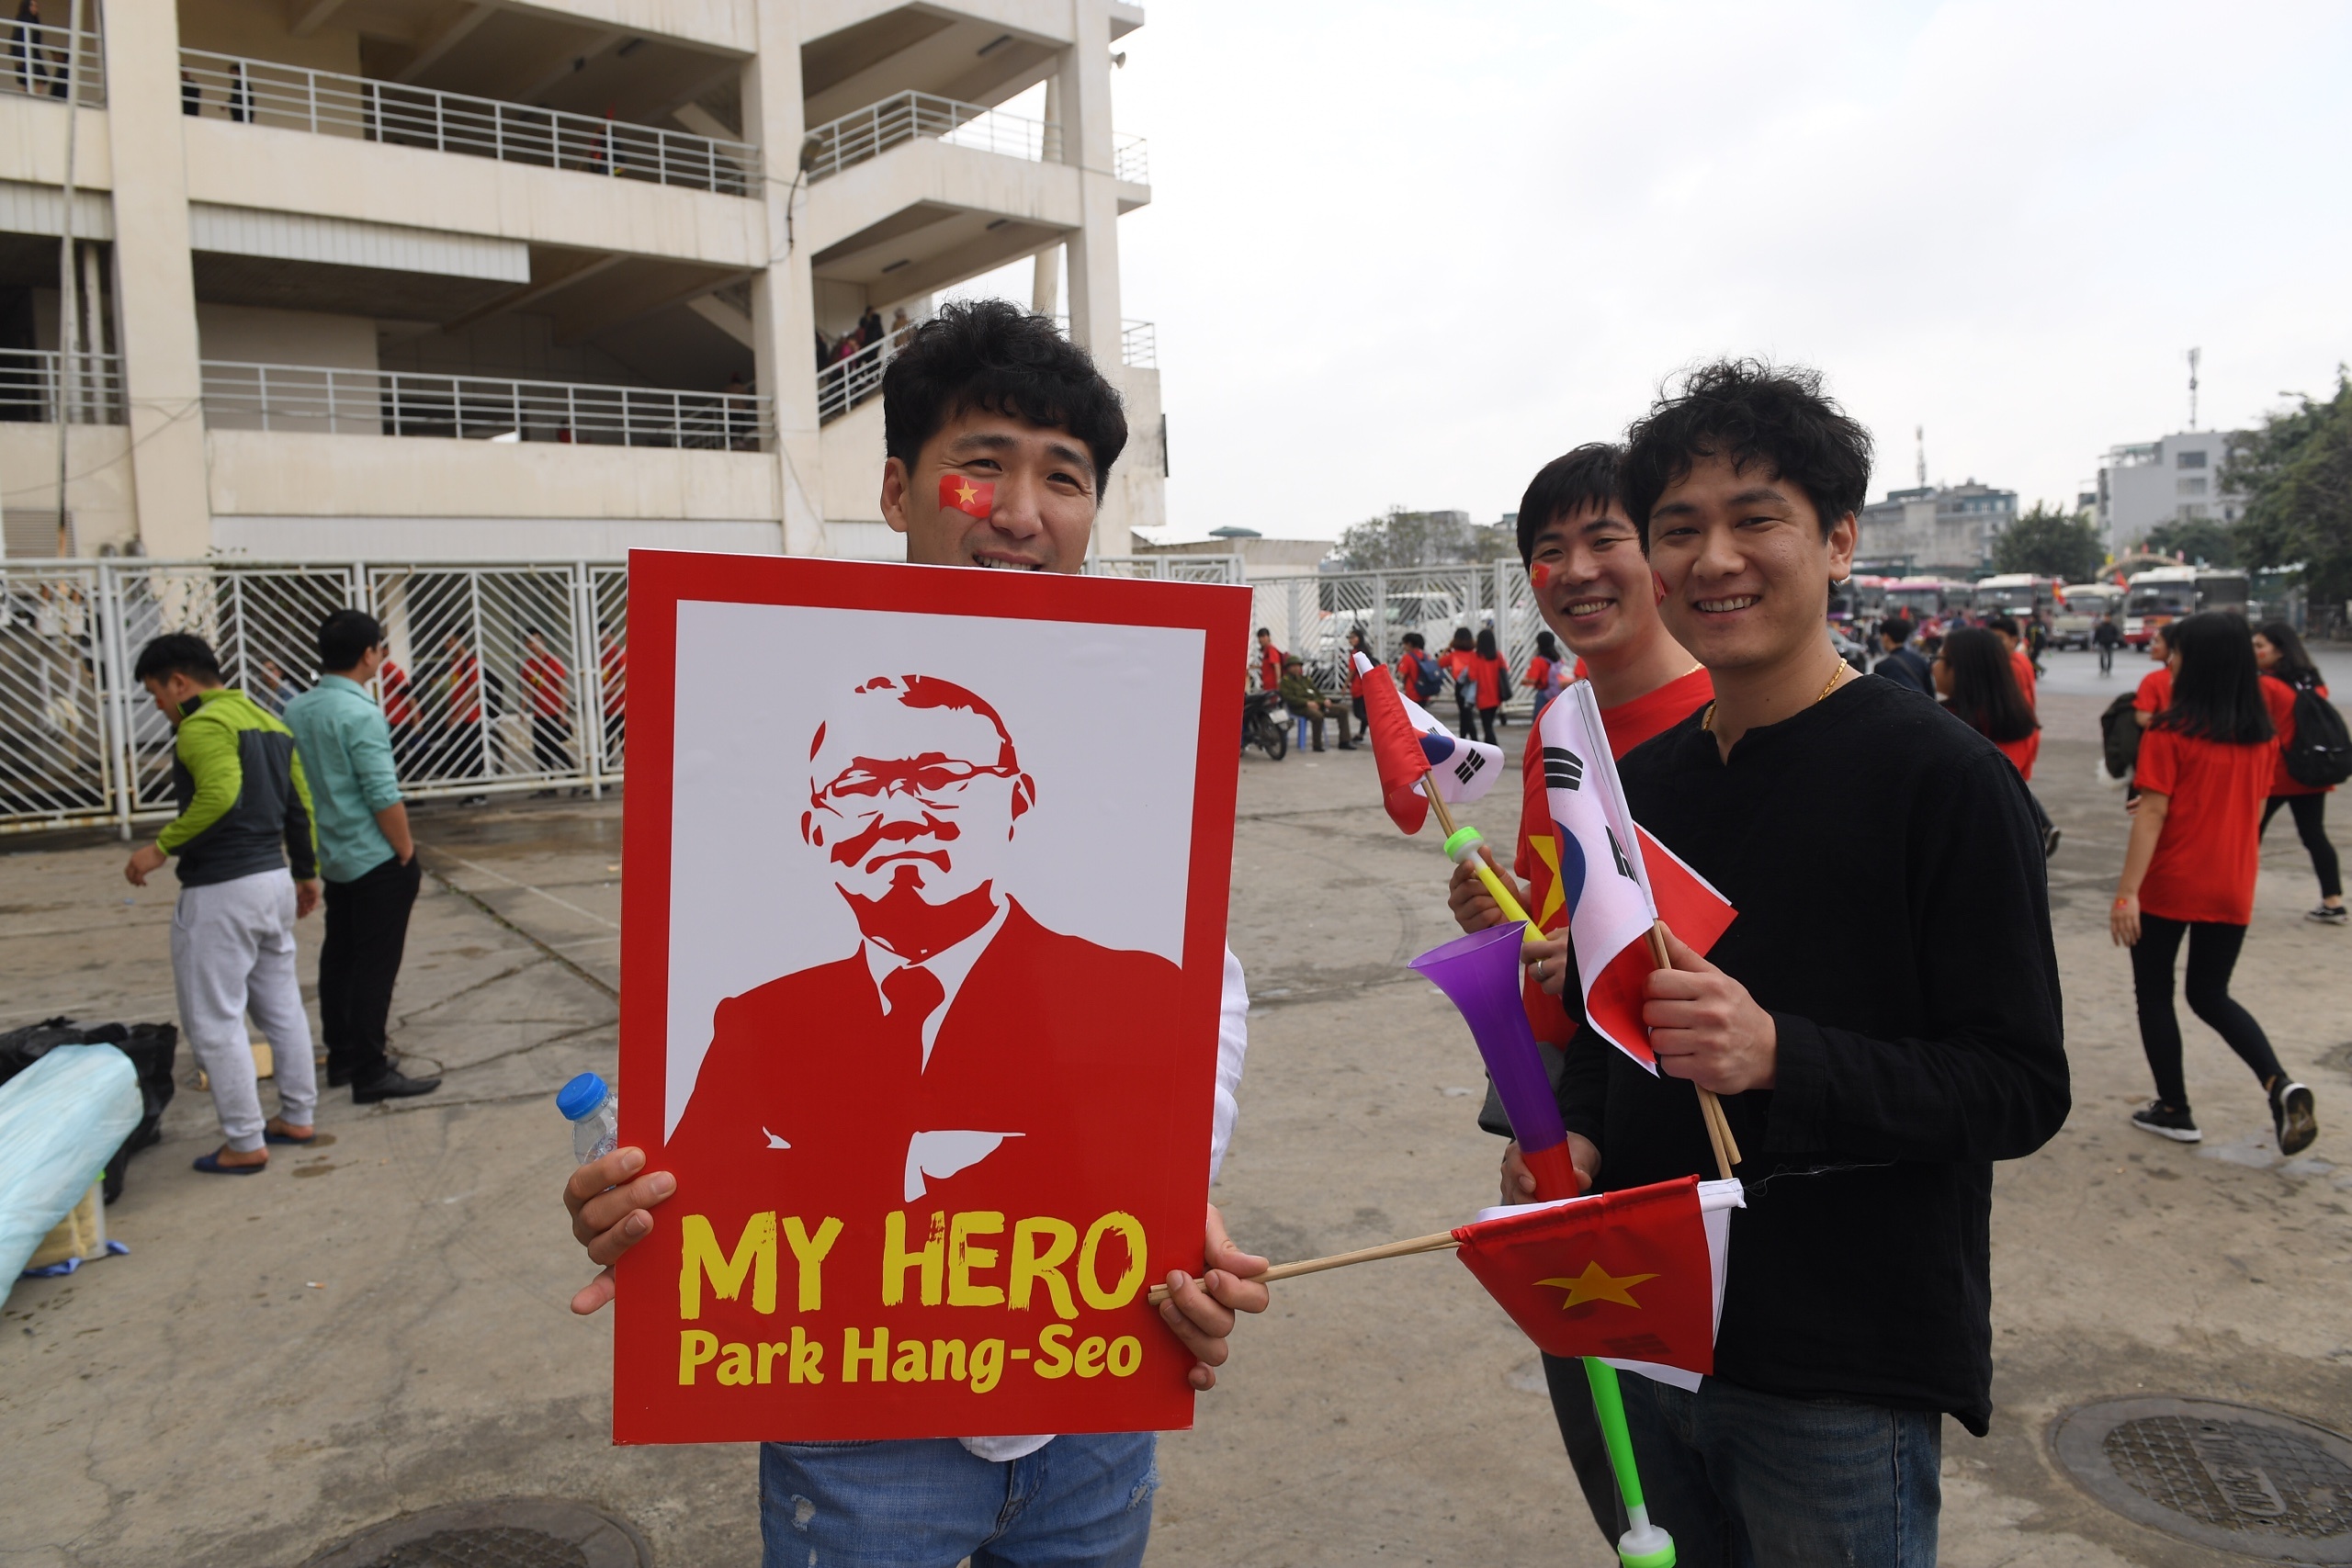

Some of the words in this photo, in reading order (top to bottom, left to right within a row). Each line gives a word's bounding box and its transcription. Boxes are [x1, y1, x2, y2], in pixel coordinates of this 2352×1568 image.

[679, 1211, 843, 1319] MY
[882, 1211, 1148, 1319] HERO
[679, 1326, 824, 1385] Park
[842, 1325, 1141, 1393] Hang-Seo
